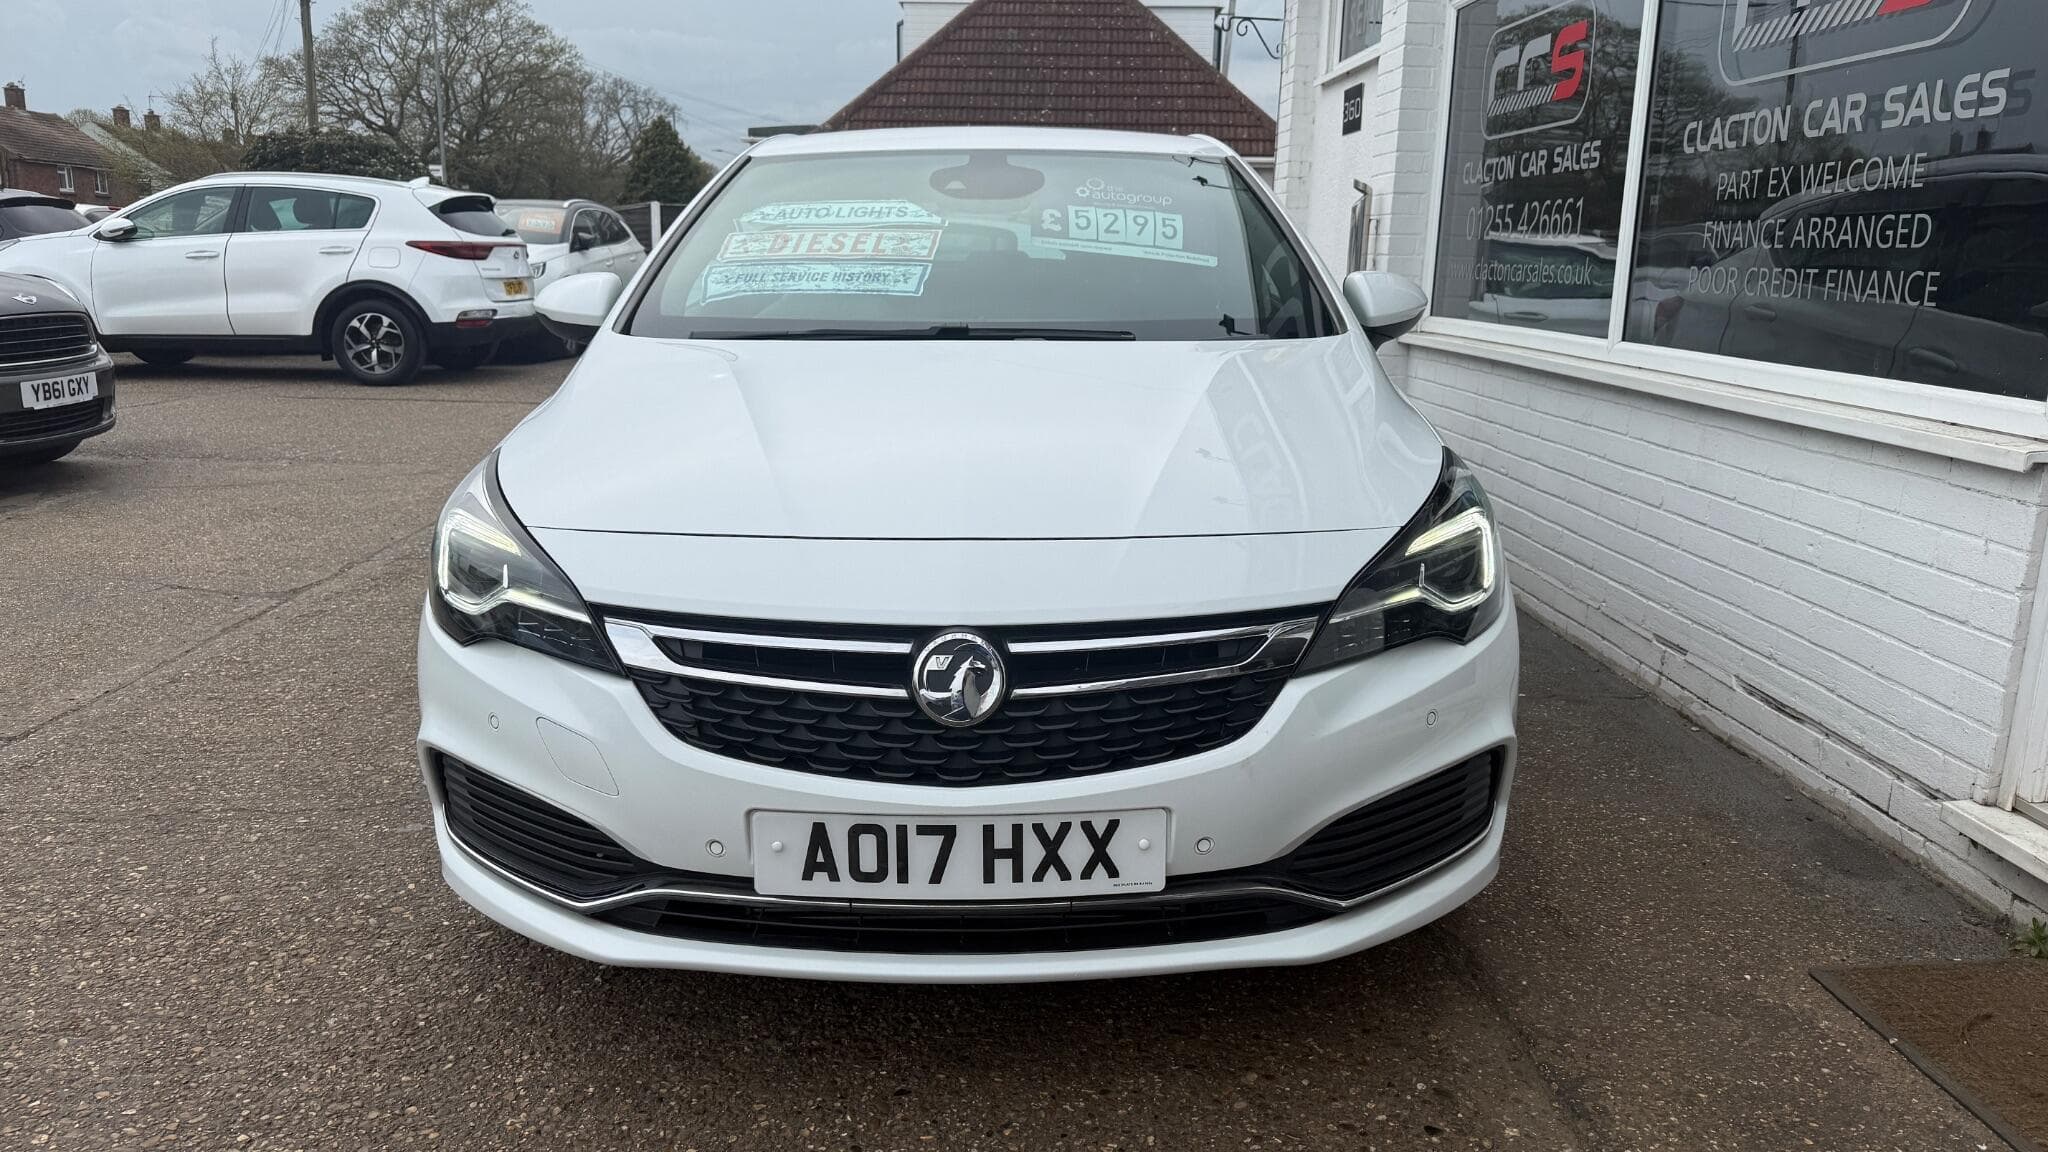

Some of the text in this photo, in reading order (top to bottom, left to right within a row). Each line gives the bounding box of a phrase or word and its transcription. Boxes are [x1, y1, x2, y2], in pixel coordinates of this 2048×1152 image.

[1343, 97, 1361, 123] 360
[1682, 67, 2011, 154] CLACTON CAR SALES
[1462, 140, 1602, 185] CLACTON CAR SALES
[1716, 152, 1928, 201] PART EX WELCOME
[771, 206, 909, 220] AUTO LIGHTS
[1092, 191, 1173, 207] autogroup
[1466, 196, 1585, 241] 01255 426661
[1702, 213, 1933, 249] FINANCE ARRANGED
[767, 232, 887, 255] DIESEL
[735, 271, 891, 284] FULL SERVICE HISTORY
[1688, 265, 1941, 307] POOR CREDIT FINANCE
[31, 375, 89, 402] YB61 GXY
[801, 818, 1121, 885] AO17 HXX
